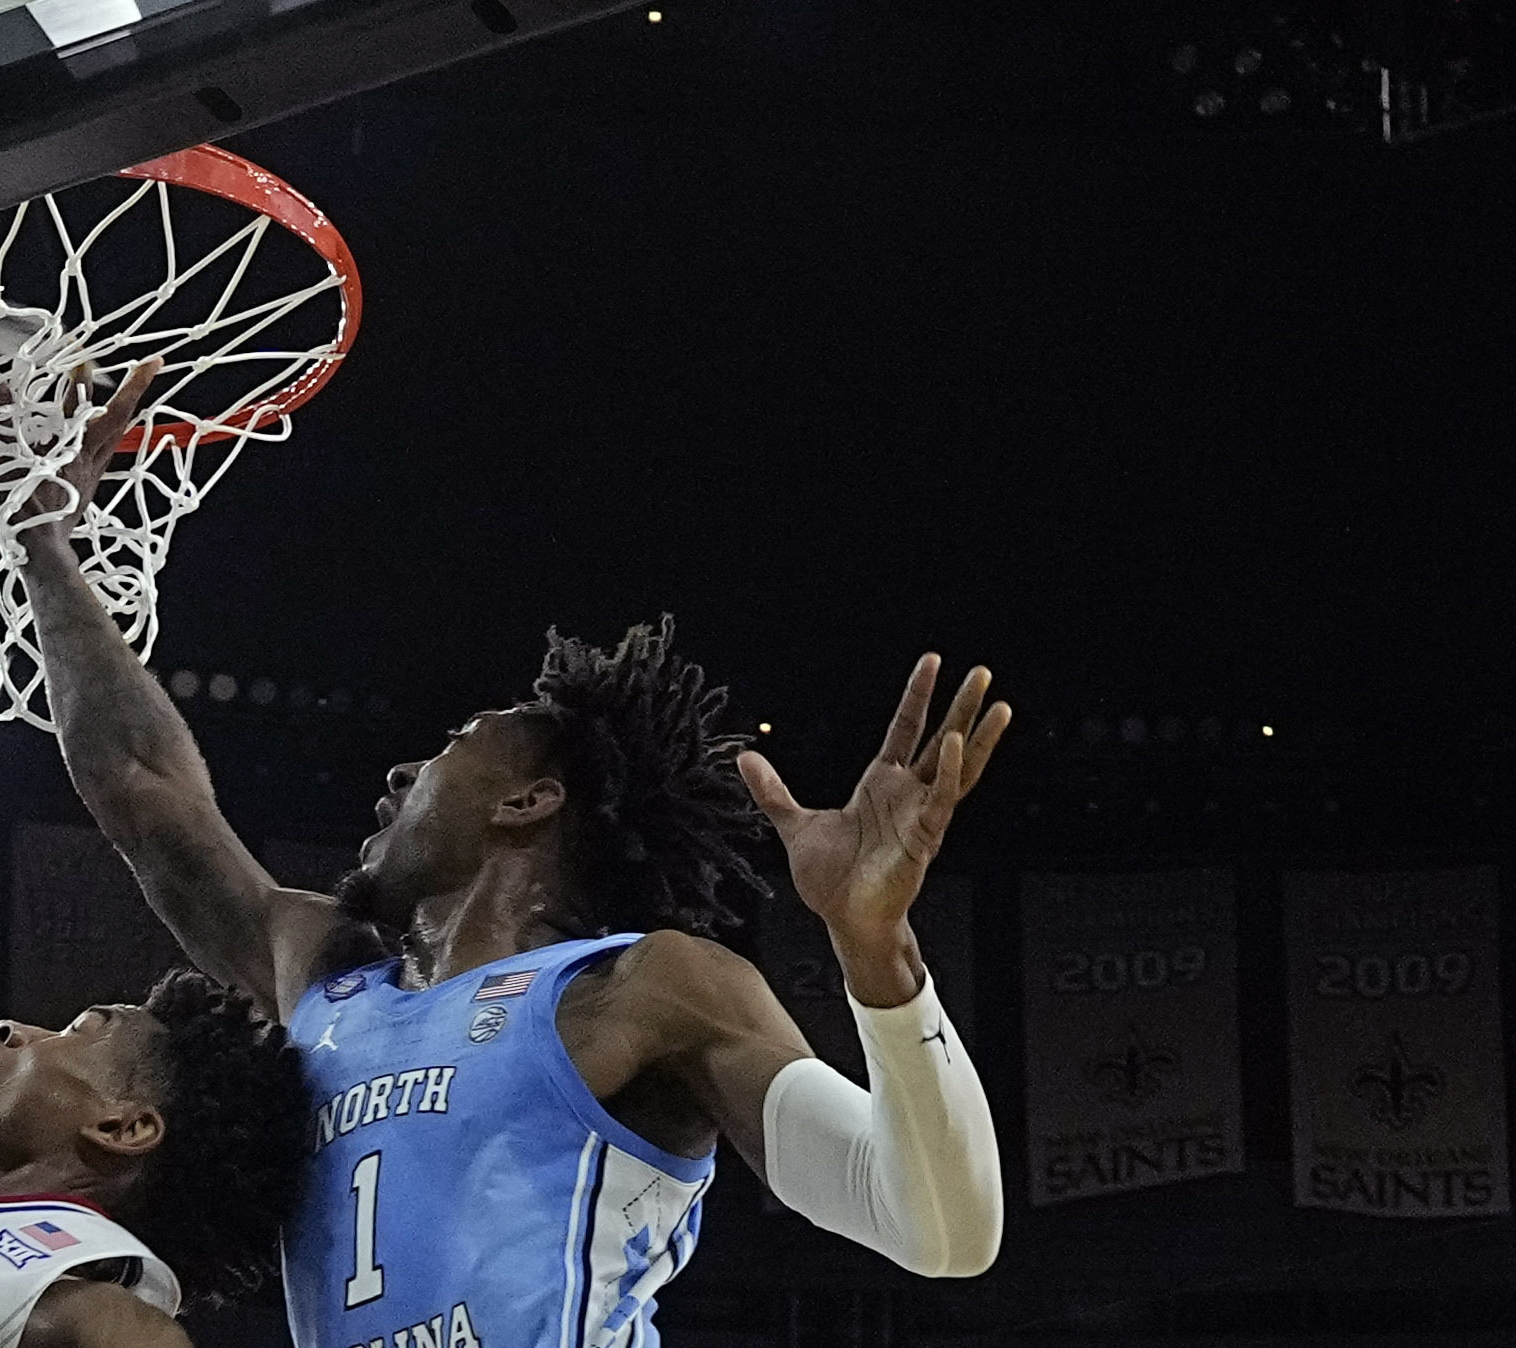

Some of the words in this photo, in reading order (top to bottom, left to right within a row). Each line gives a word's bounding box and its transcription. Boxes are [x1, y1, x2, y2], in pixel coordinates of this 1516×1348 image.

[1052, 946, 1205, 993] 2009
[1315, 953, 1470, 998] 2009
[315, 1065, 457, 1152] NORTH
[1311, 1167, 1491, 1207] SAINTS
[344, 1150, 384, 1310] 1
